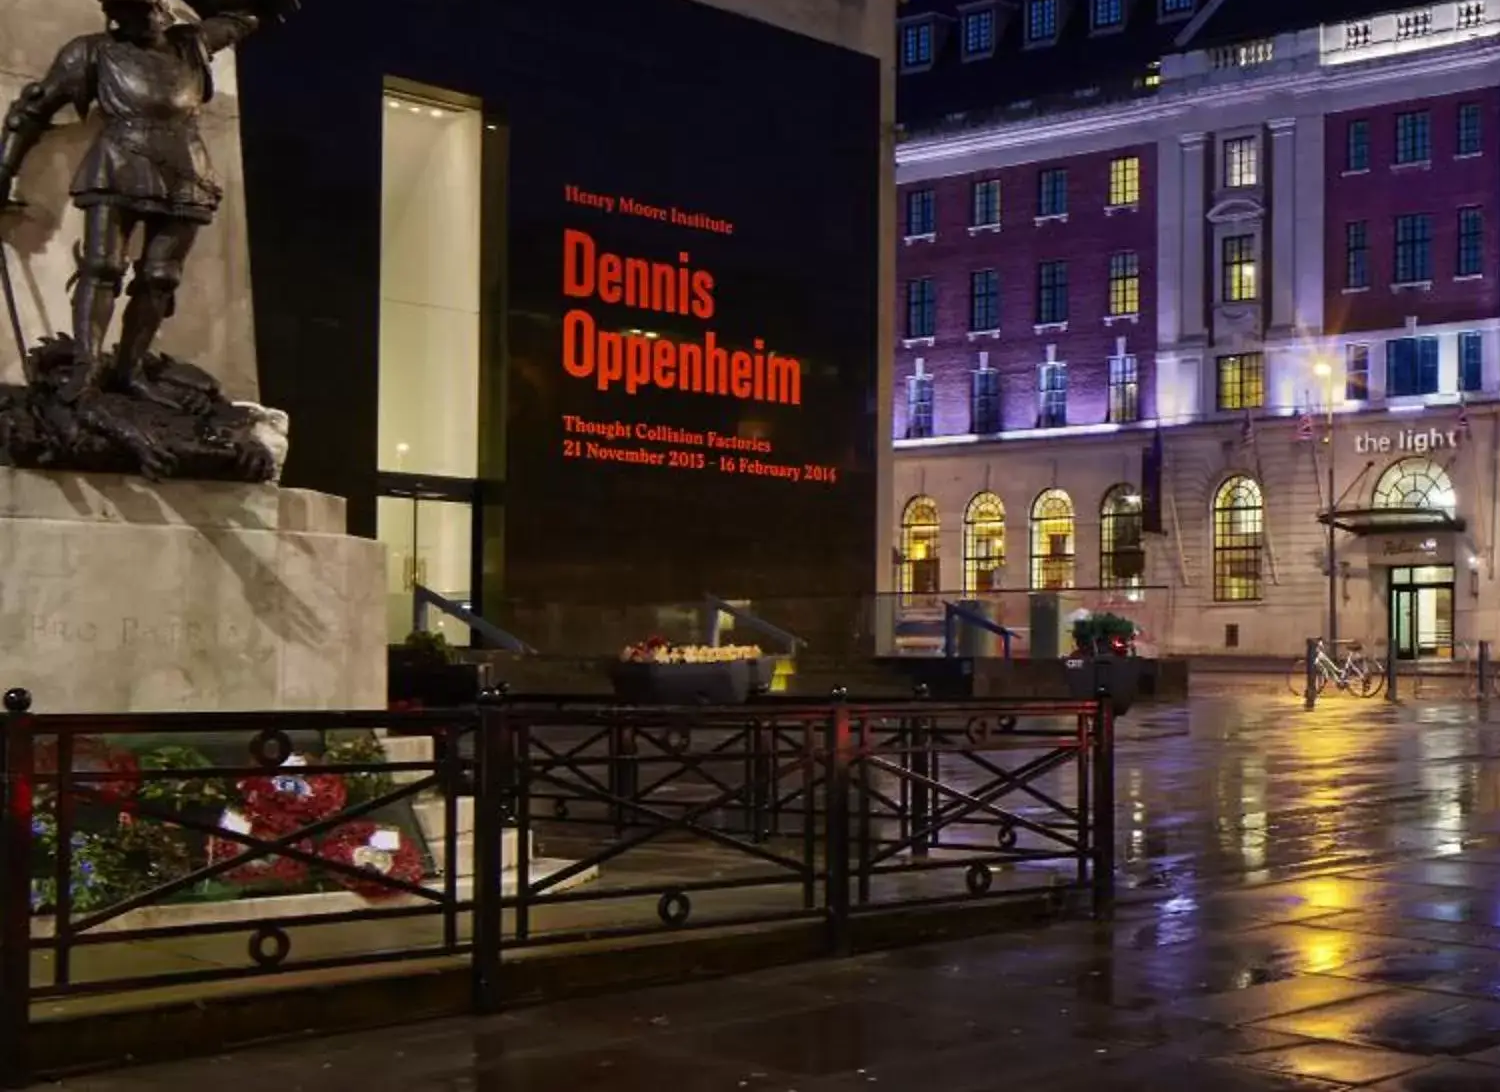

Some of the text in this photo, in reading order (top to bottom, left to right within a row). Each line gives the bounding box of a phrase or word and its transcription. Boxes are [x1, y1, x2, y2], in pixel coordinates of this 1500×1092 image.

[565, 185, 734, 235] Henry Moore Institute
[562, 228, 716, 321] Dennis
[562, 309, 802, 405] Oppenheim
[562, 415, 772, 454] Thought Collision Factories
[1355, 428, 1457, 453] the light
[563, 439, 582, 458] 21
[586, 442, 665, 466] November
[719, 456, 736, 473] 16
[738, 458, 801, 483] February
[803, 465, 837, 484] 2014
